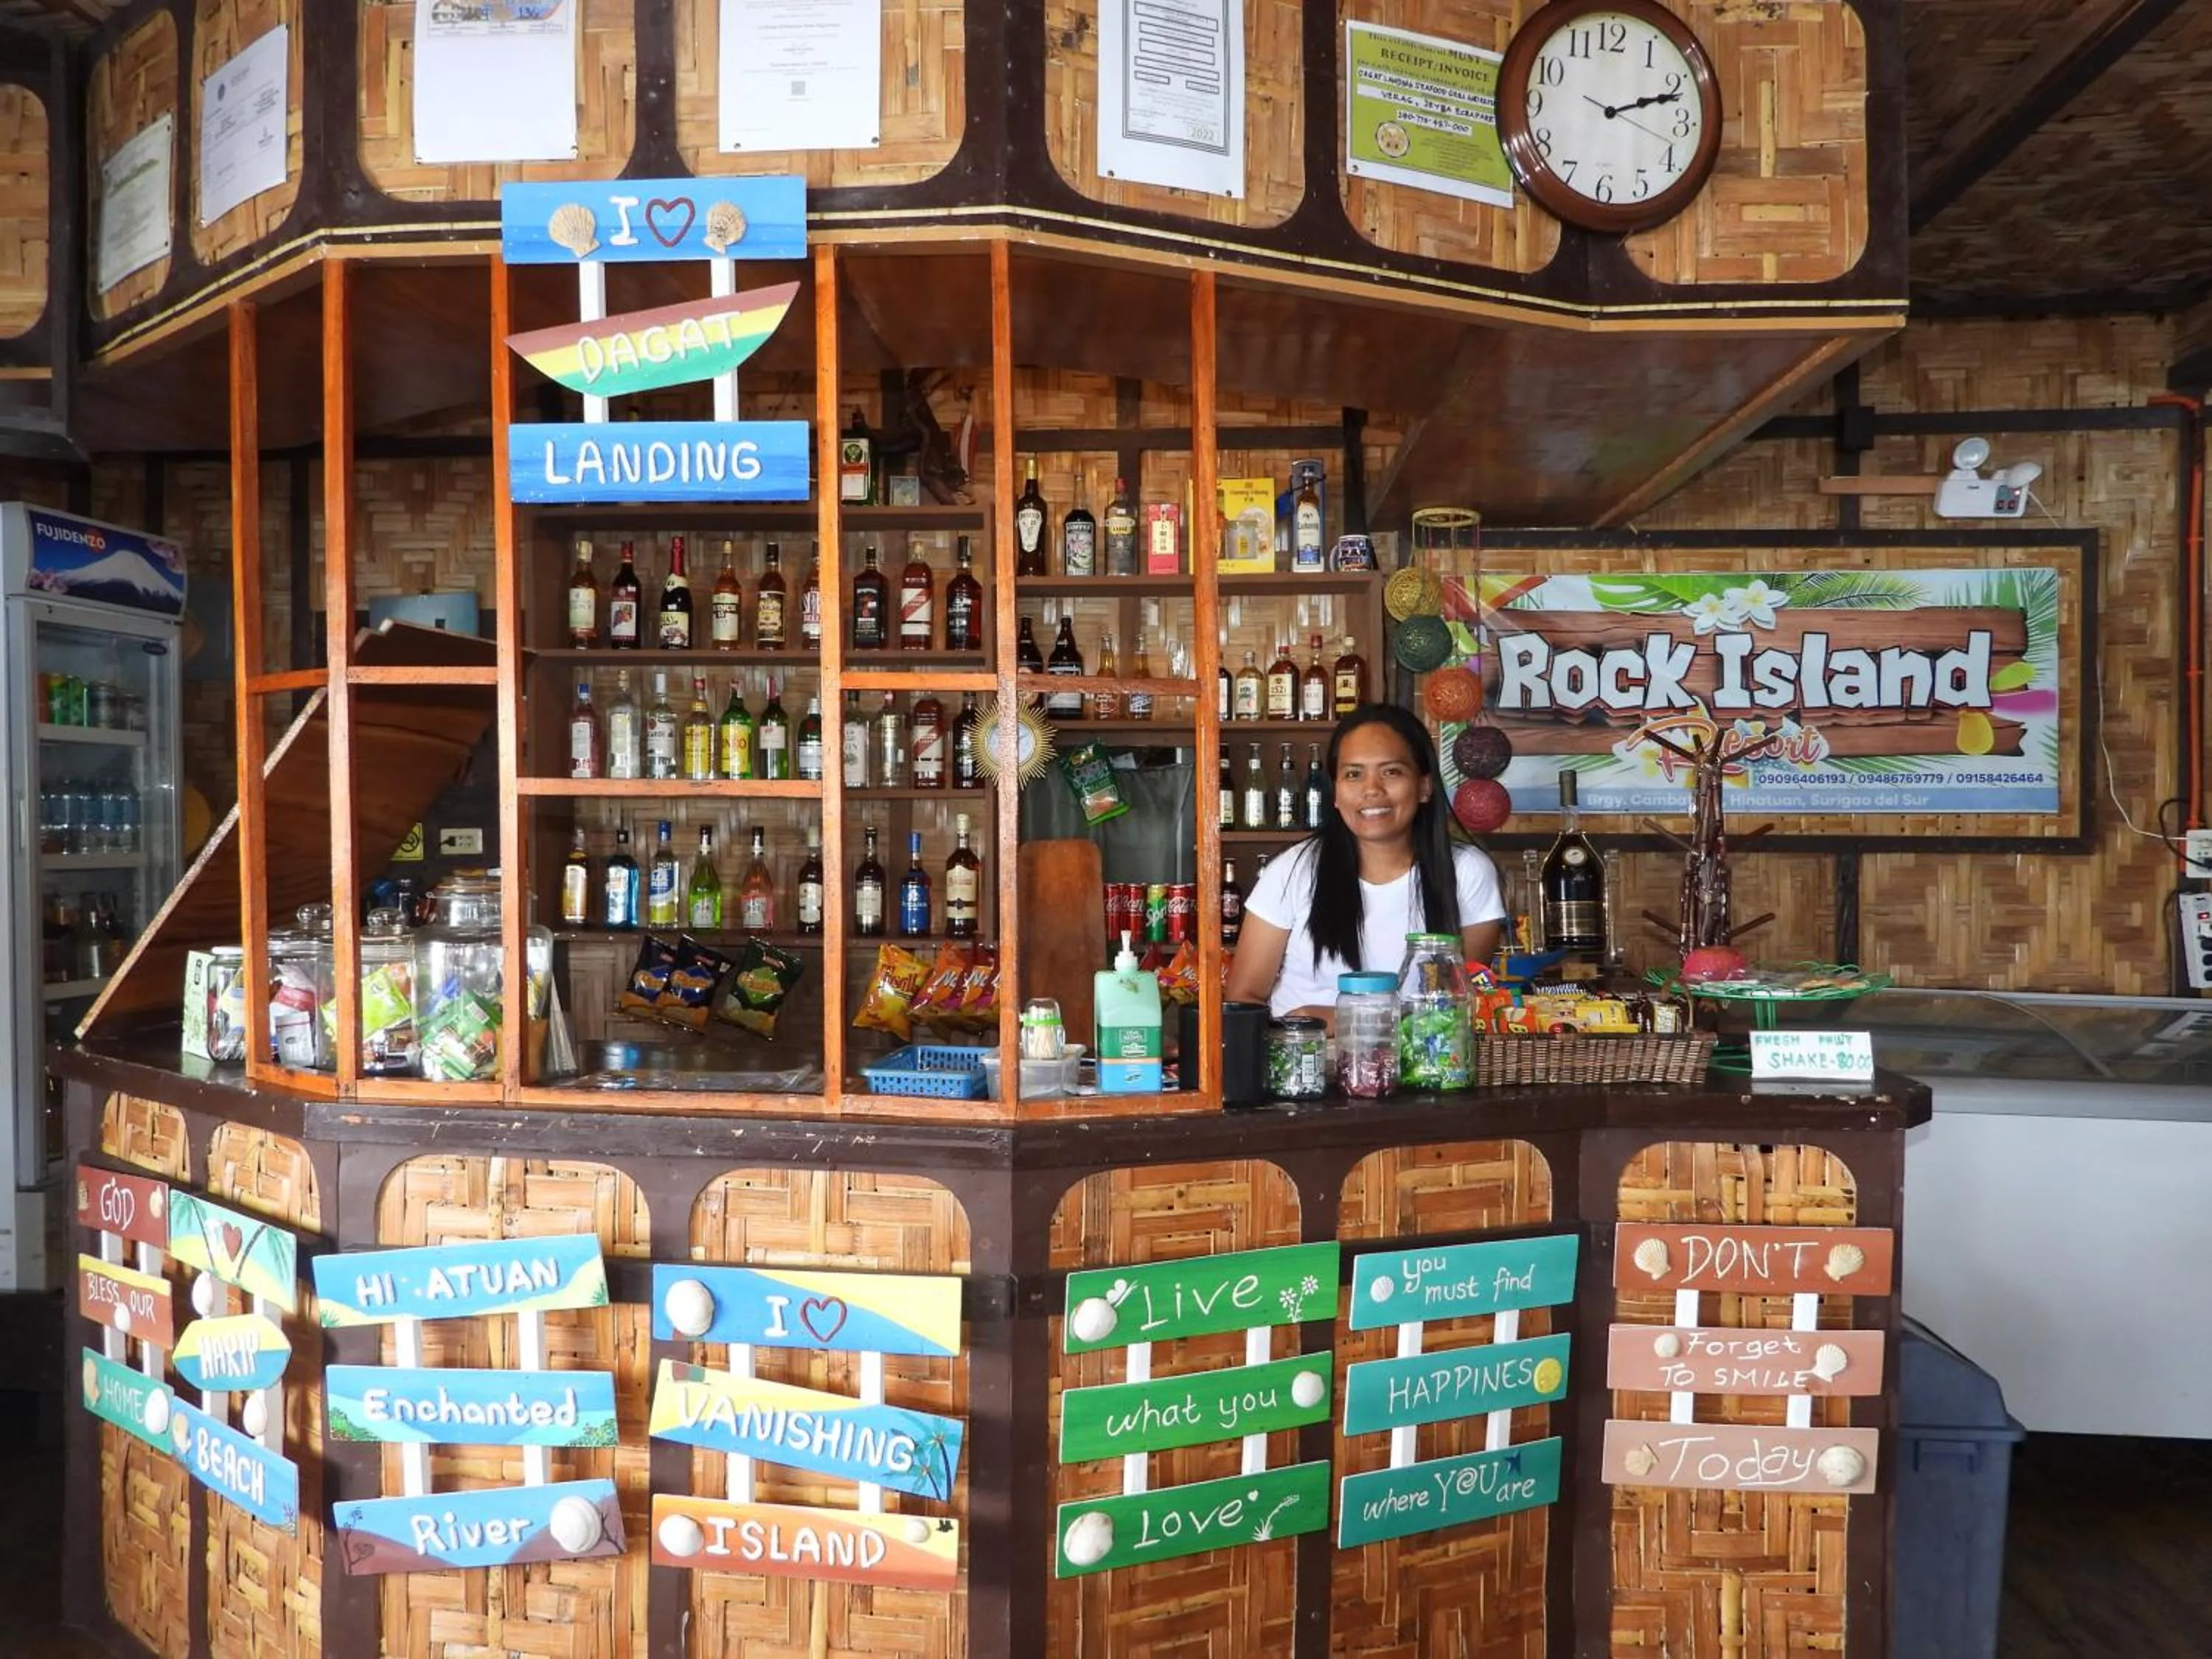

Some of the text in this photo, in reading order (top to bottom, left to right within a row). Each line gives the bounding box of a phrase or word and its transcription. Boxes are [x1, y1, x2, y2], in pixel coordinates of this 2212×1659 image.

[1569, 29, 1590, 59] 11
[1598, 21, 1627, 53] 12
[1644, 40, 1653, 69] 1
[1538, 56, 1565, 87] 10
[1665, 72, 1681, 102] 2
[1527, 88, 1543, 118] 9
[1672, 108, 1689, 138] 3
[1535, 128, 1551, 158] 8
[1659, 144, 1675, 173] 4
[1562, 160, 1578, 184] 7
[1595, 175, 1613, 204] 6
[1632, 169, 1648, 198] 5
[609, 195, 640, 246] I
[577, 310, 741, 384] DAGAT
[544, 439, 762, 485] LANDING
[37, 522, 106, 550] FUJIDENZO
[1497, 629, 1994, 710] Rock Island
[1759, 773, 1846, 785] 09096406193
[1955, 773, 2044, 784] 09158426464
[1587, 794, 1627, 808] Brgy.
[1733, 793, 1806, 807] Hinatuan,
[1809, 794, 1871, 808] Surigao
[1875, 793, 1899, 806] del
[1902, 794, 1930, 806] Sur
[100, 1183, 135, 1231] GOD
[1680, 1235, 1818, 1284] DON'T
[86, 1272, 156, 1324] BLESS OUR
[1140, 1274, 1264, 1331] Live
[1425, 1263, 1536, 1304] must find
[764, 1295, 791, 1338] I
[1686, 1332, 1802, 1360] Forget
[1659, 1363, 1814, 1388] TO SMILE
[103, 1375, 145, 1424] HOME
[363, 1386, 580, 1427] Enchanted
[1107, 1388, 1278, 1436] what you
[681, 1385, 918, 1472] VANISHING
[196, 1427, 266, 1506] BEACH
[1658, 1436, 1816, 1487] Today
[1363, 1488, 1430, 1521] where
[1496, 1477, 1535, 1503] are
[409, 1511, 533, 1557] River
[703, 1516, 886, 1570] ISLAND
[1133, 1499, 1245, 1549] Love
